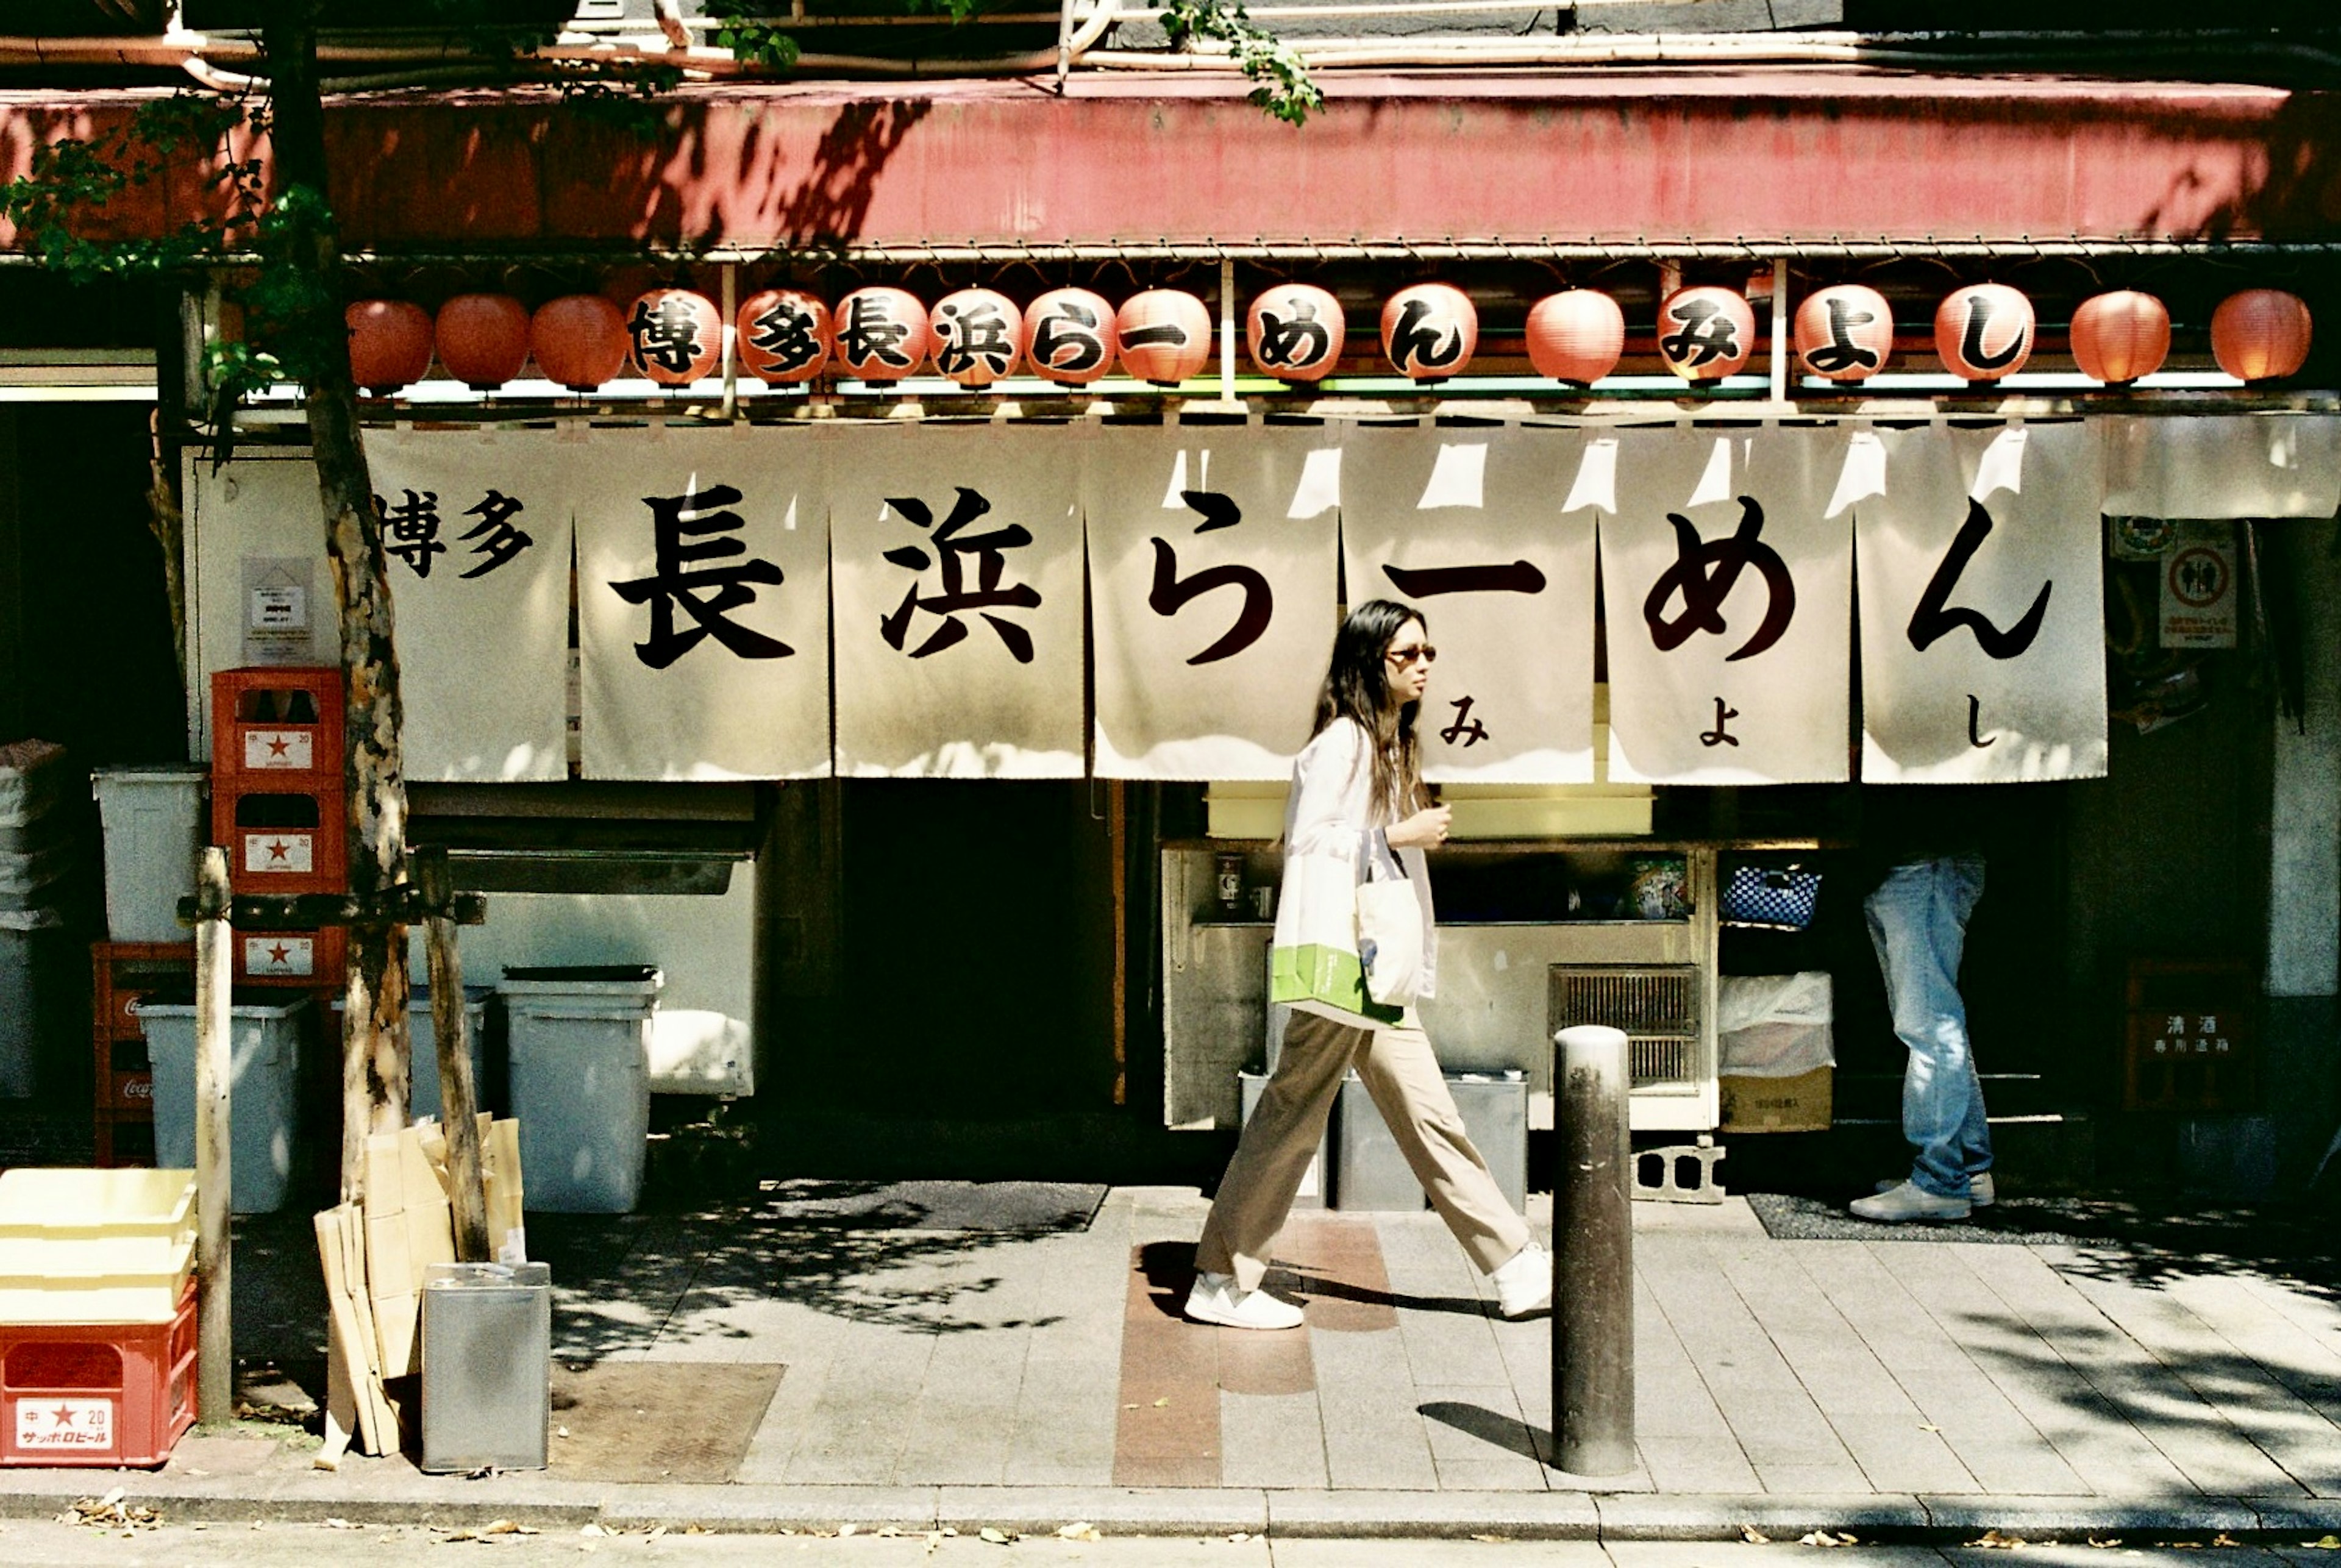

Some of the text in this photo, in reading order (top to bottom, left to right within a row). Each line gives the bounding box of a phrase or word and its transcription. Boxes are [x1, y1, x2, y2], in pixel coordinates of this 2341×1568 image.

[627, 296, 2026, 374] 博多長浜らーめん みよし
[373, 488, 534, 579] 博多
[607, 485, 2053, 669] 長浜らーめん
[1441, 694, 1997, 747] みよし
[2167, 1015, 2217, 1035] 清酒
[22, 1431, 106, 1444] サッポロビール
[25, 1410, 105, 1425] 中 20
